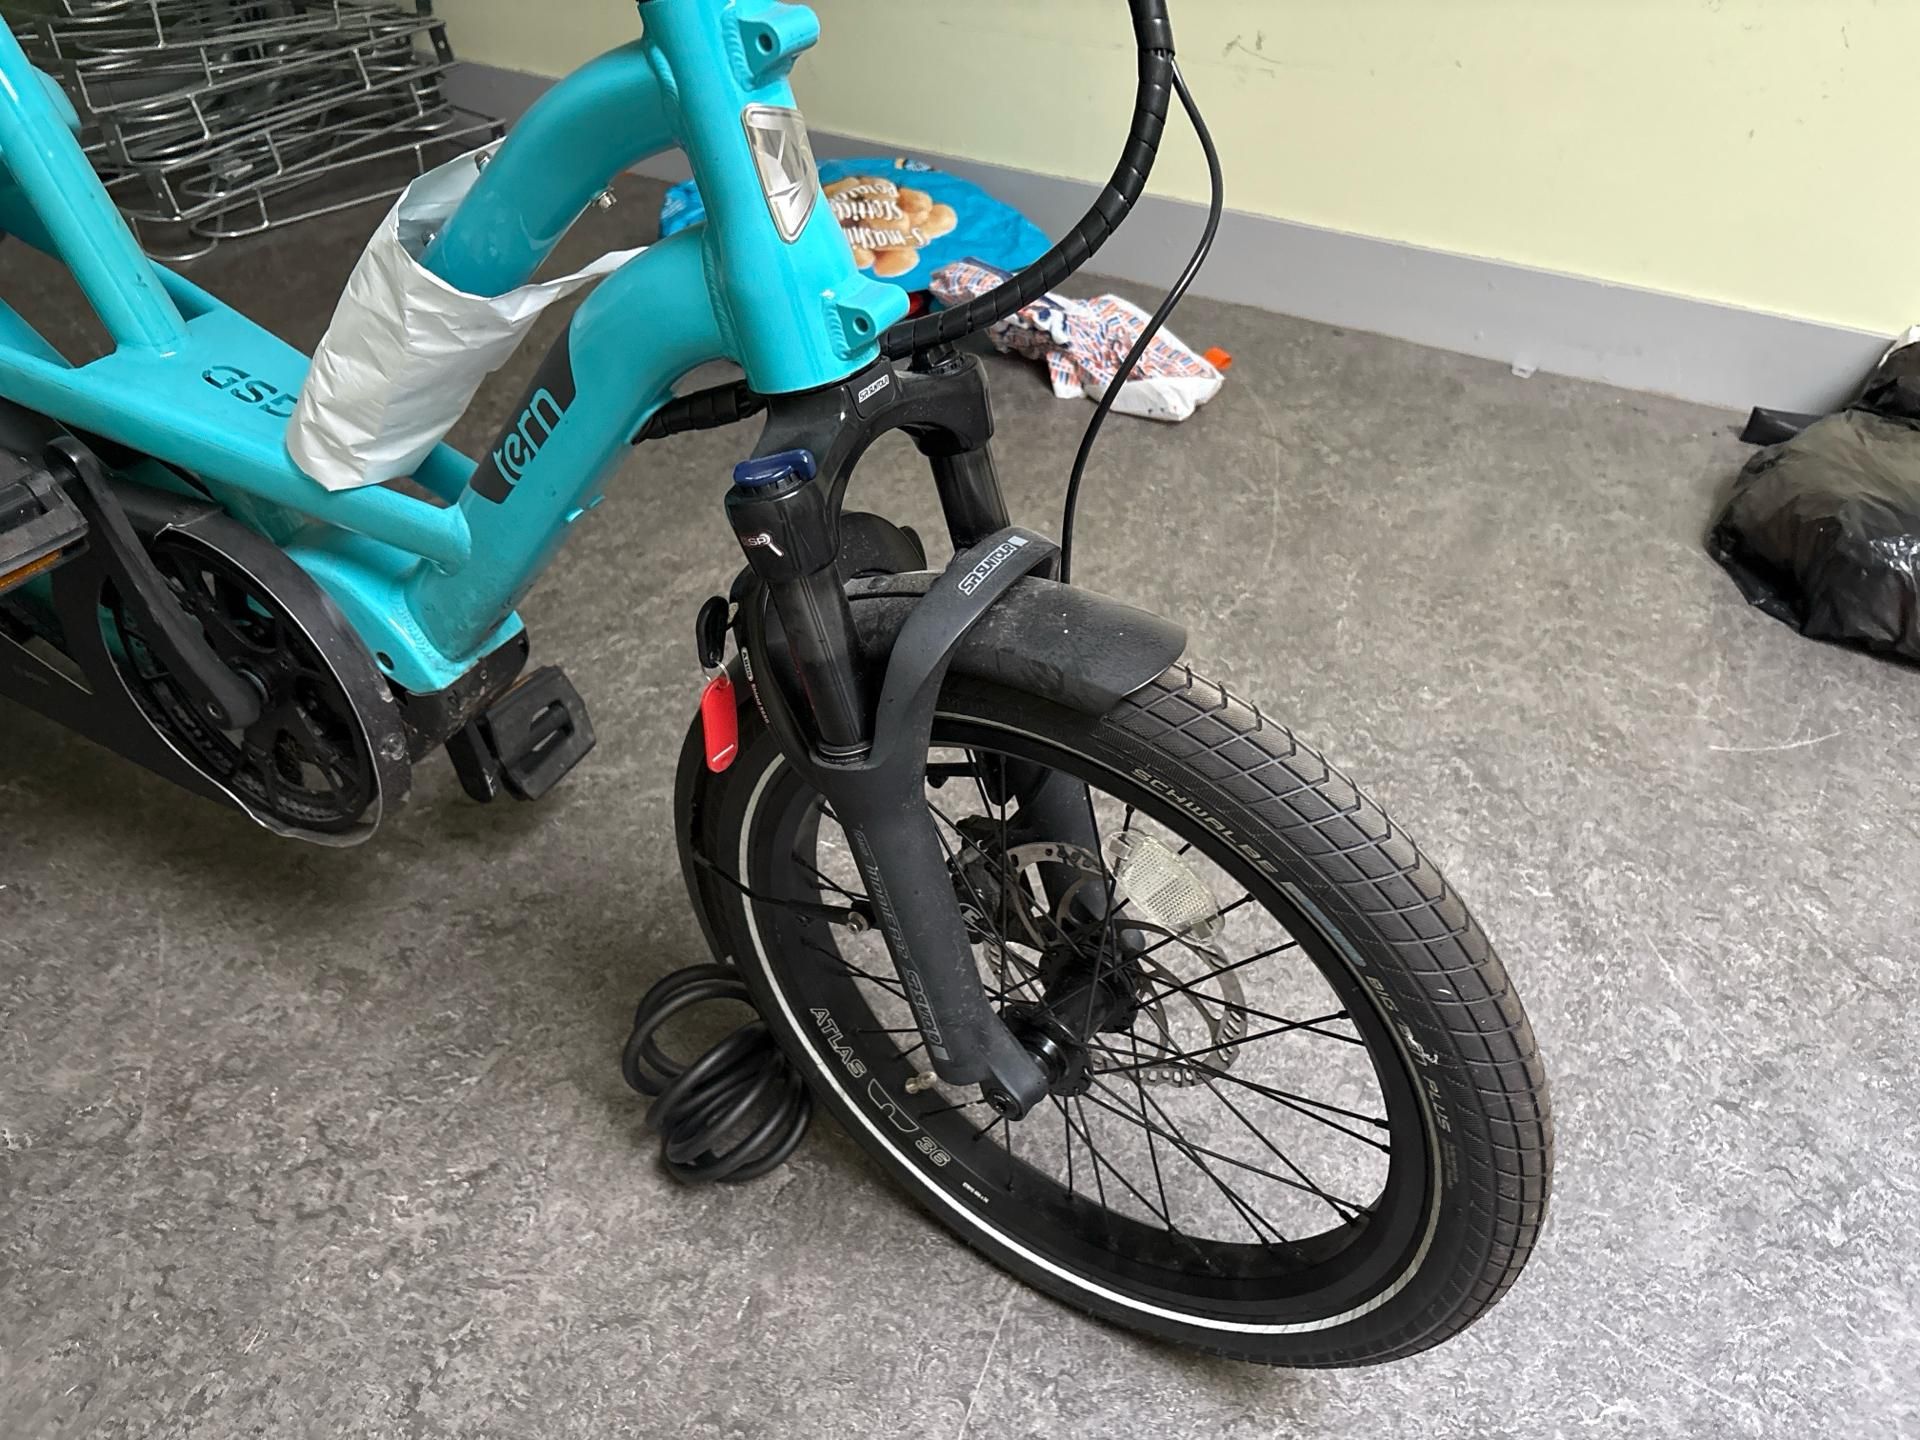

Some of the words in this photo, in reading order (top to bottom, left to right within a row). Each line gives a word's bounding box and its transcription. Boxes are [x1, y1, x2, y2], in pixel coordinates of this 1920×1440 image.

[493, 388, 563, 486] tern
[958, 571, 982, 596] SR
[973, 543, 1018, 580] SUNTOUR
[1132, 768, 1279, 873] SCHWALBE
[810, 1008, 867, 1078] ATLAS
[1366, 976, 1399, 1012] BIG
[1423, 1075, 1451, 1132] PLUS
[915, 1136, 951, 1167] 36
